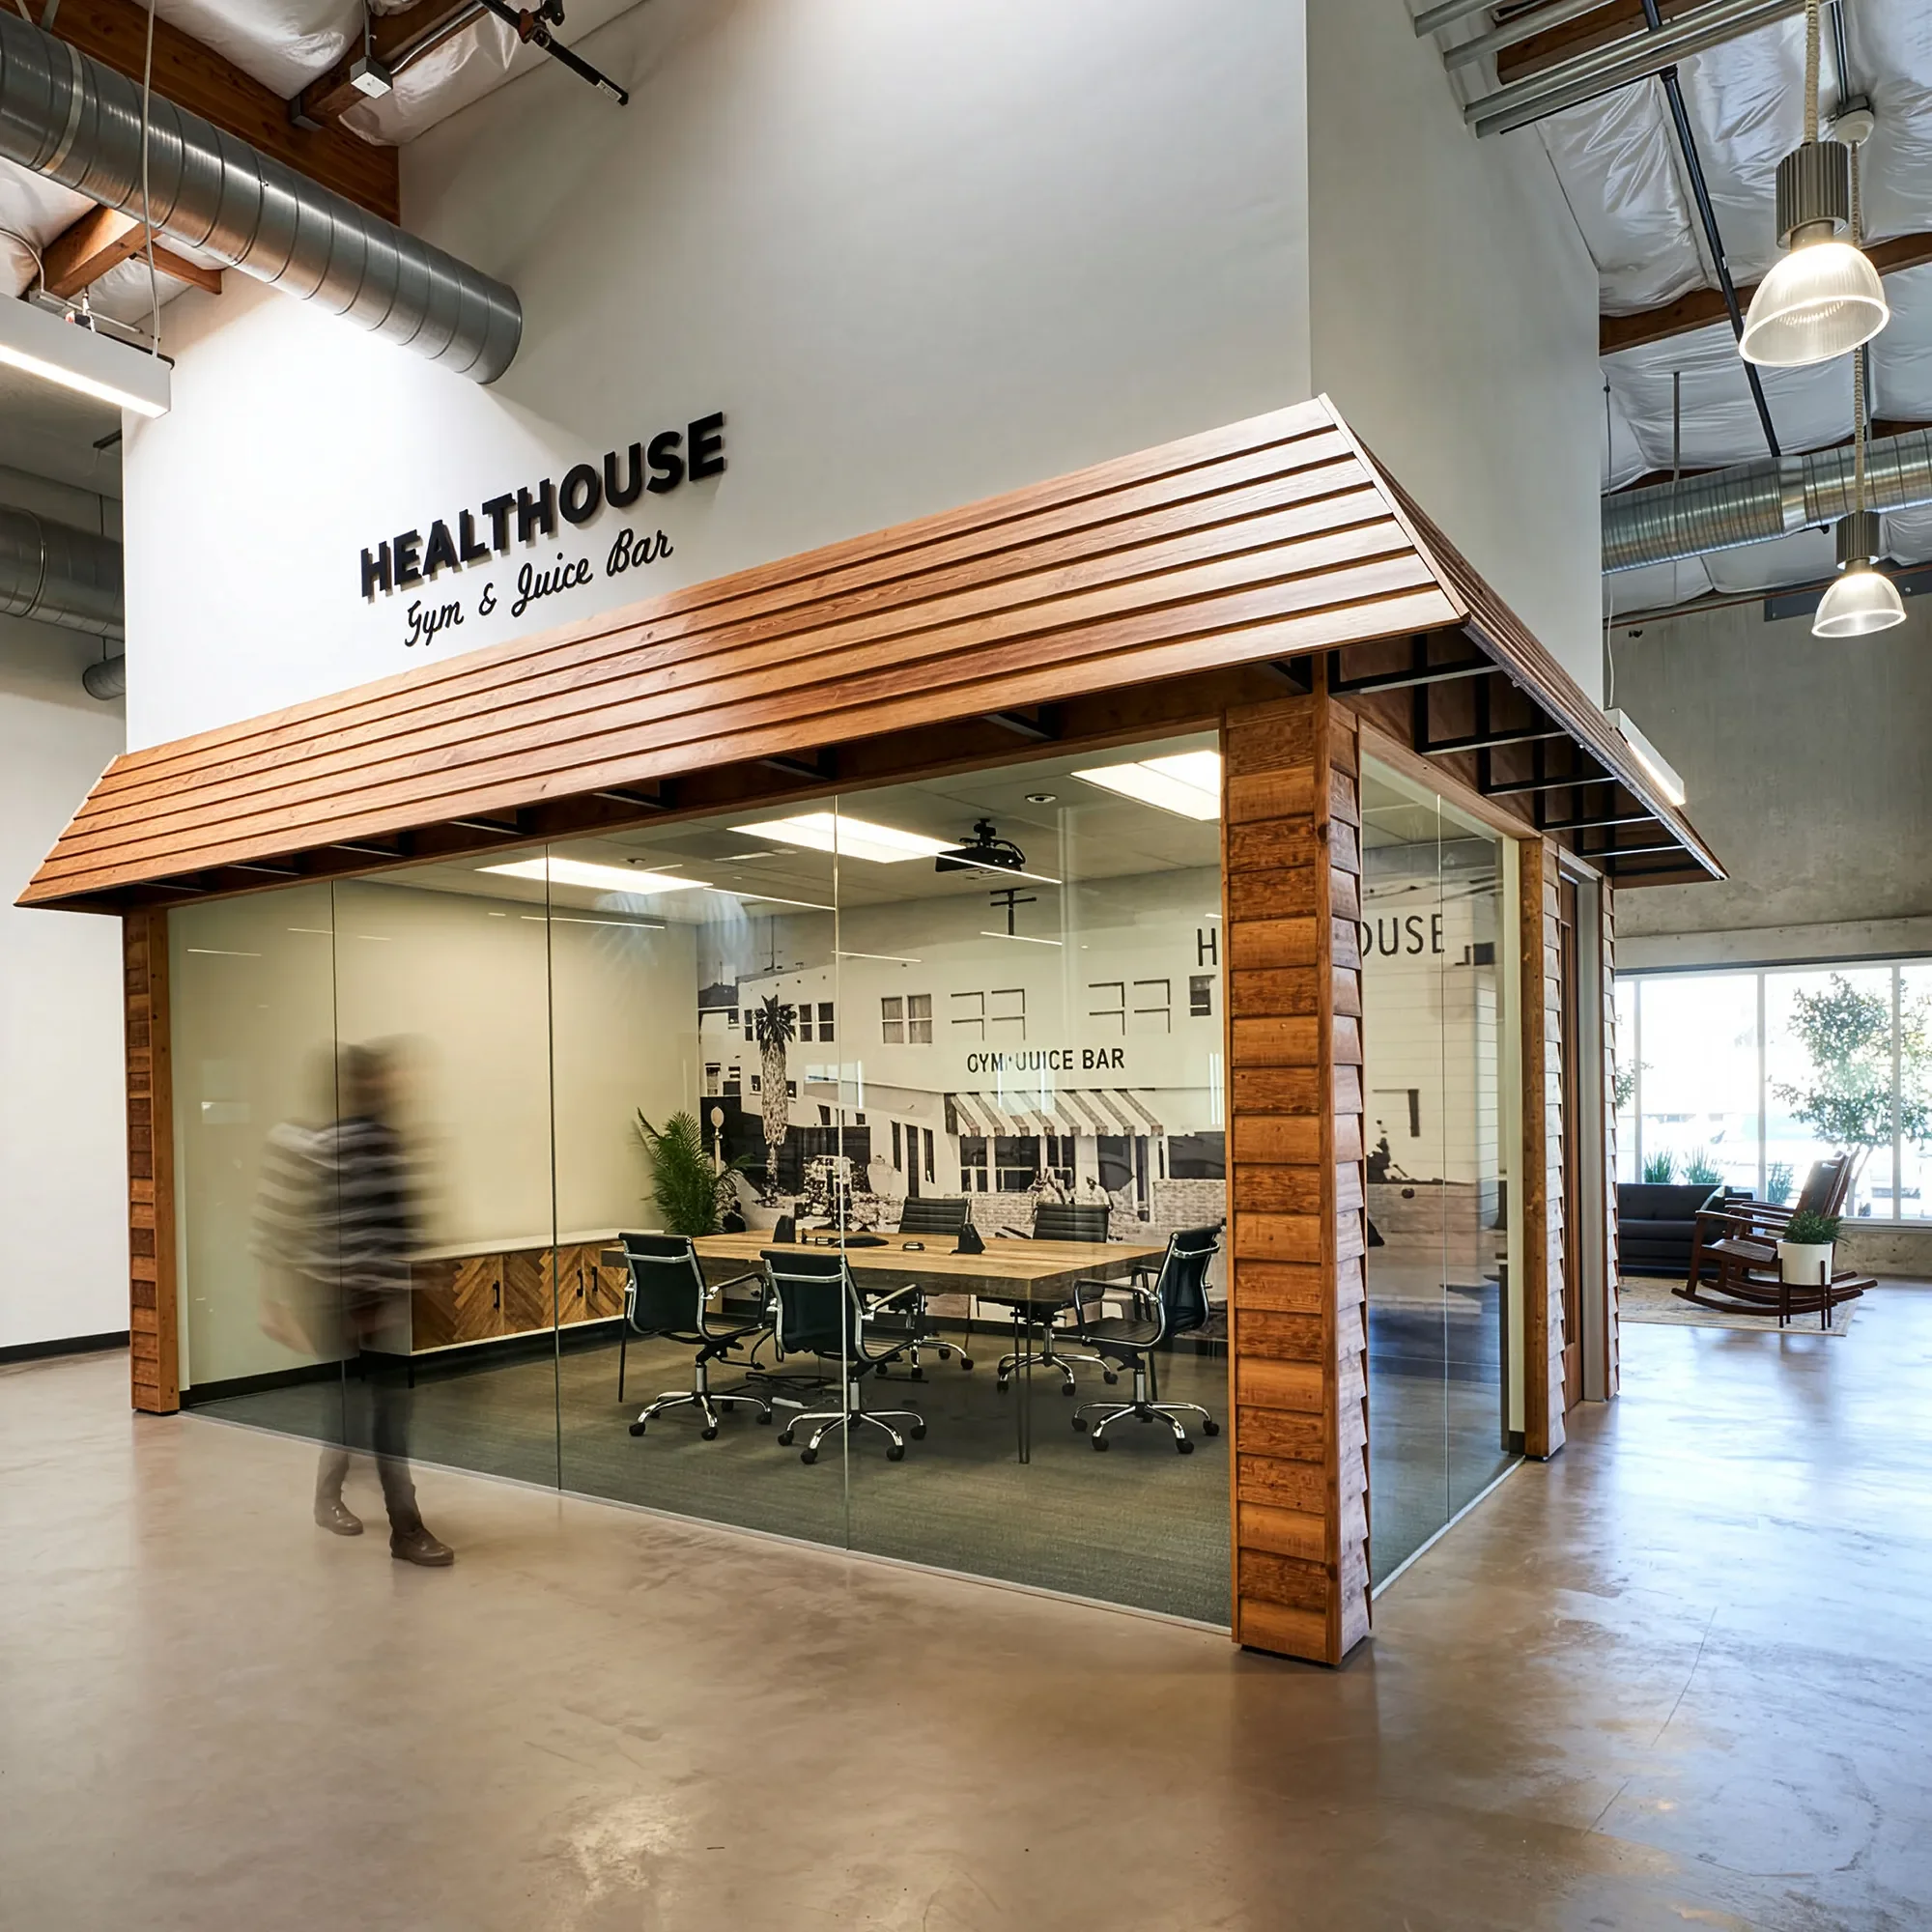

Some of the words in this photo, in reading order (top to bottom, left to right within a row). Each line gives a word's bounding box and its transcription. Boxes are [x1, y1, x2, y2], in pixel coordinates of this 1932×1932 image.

[360, 411, 725, 600] HEALTHOUSE
[405, 600, 464, 646] Gym
[478, 582, 497, 616] &
[511, 553, 592, 617] Juice
[606, 527, 673, 577] Bar
[1082, 1047, 1124, 1069] BAR
